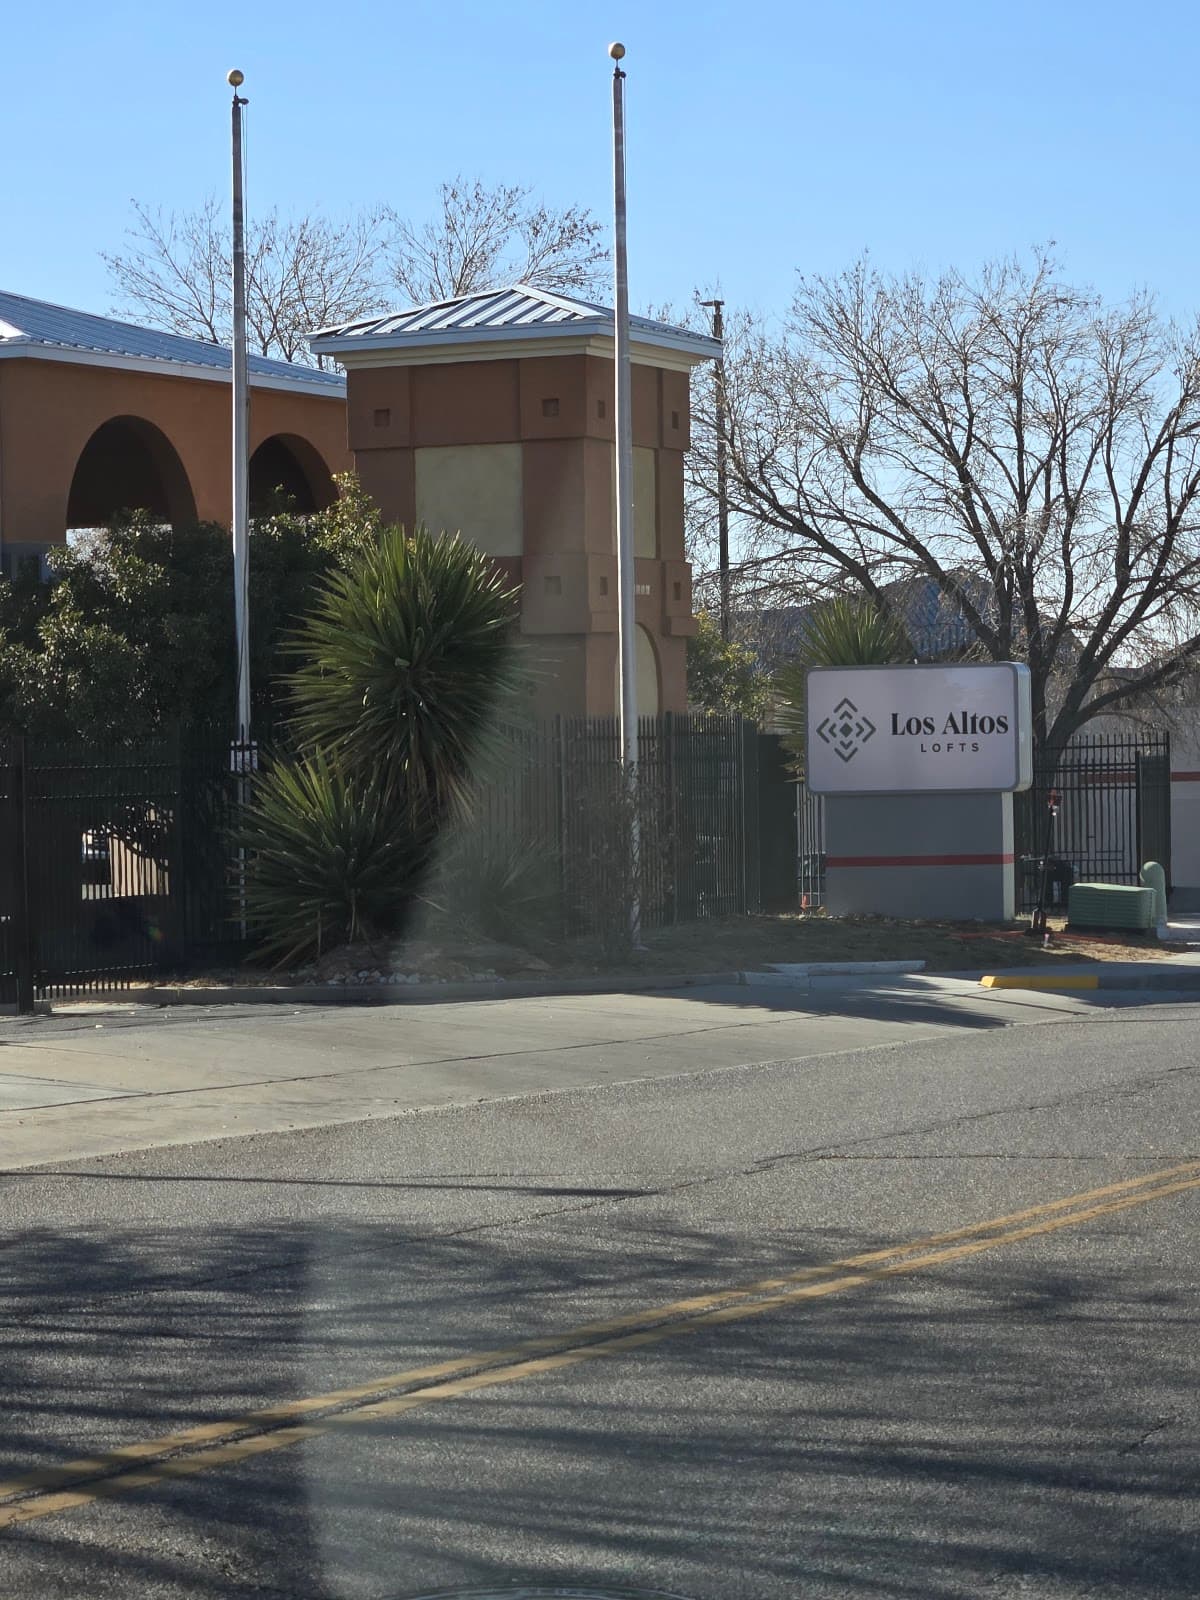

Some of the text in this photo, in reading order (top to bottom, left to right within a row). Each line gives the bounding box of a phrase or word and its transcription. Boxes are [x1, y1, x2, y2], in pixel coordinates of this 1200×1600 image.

[891, 711, 1009, 736] Los Altos
[920, 742, 980, 753] LOFTS
